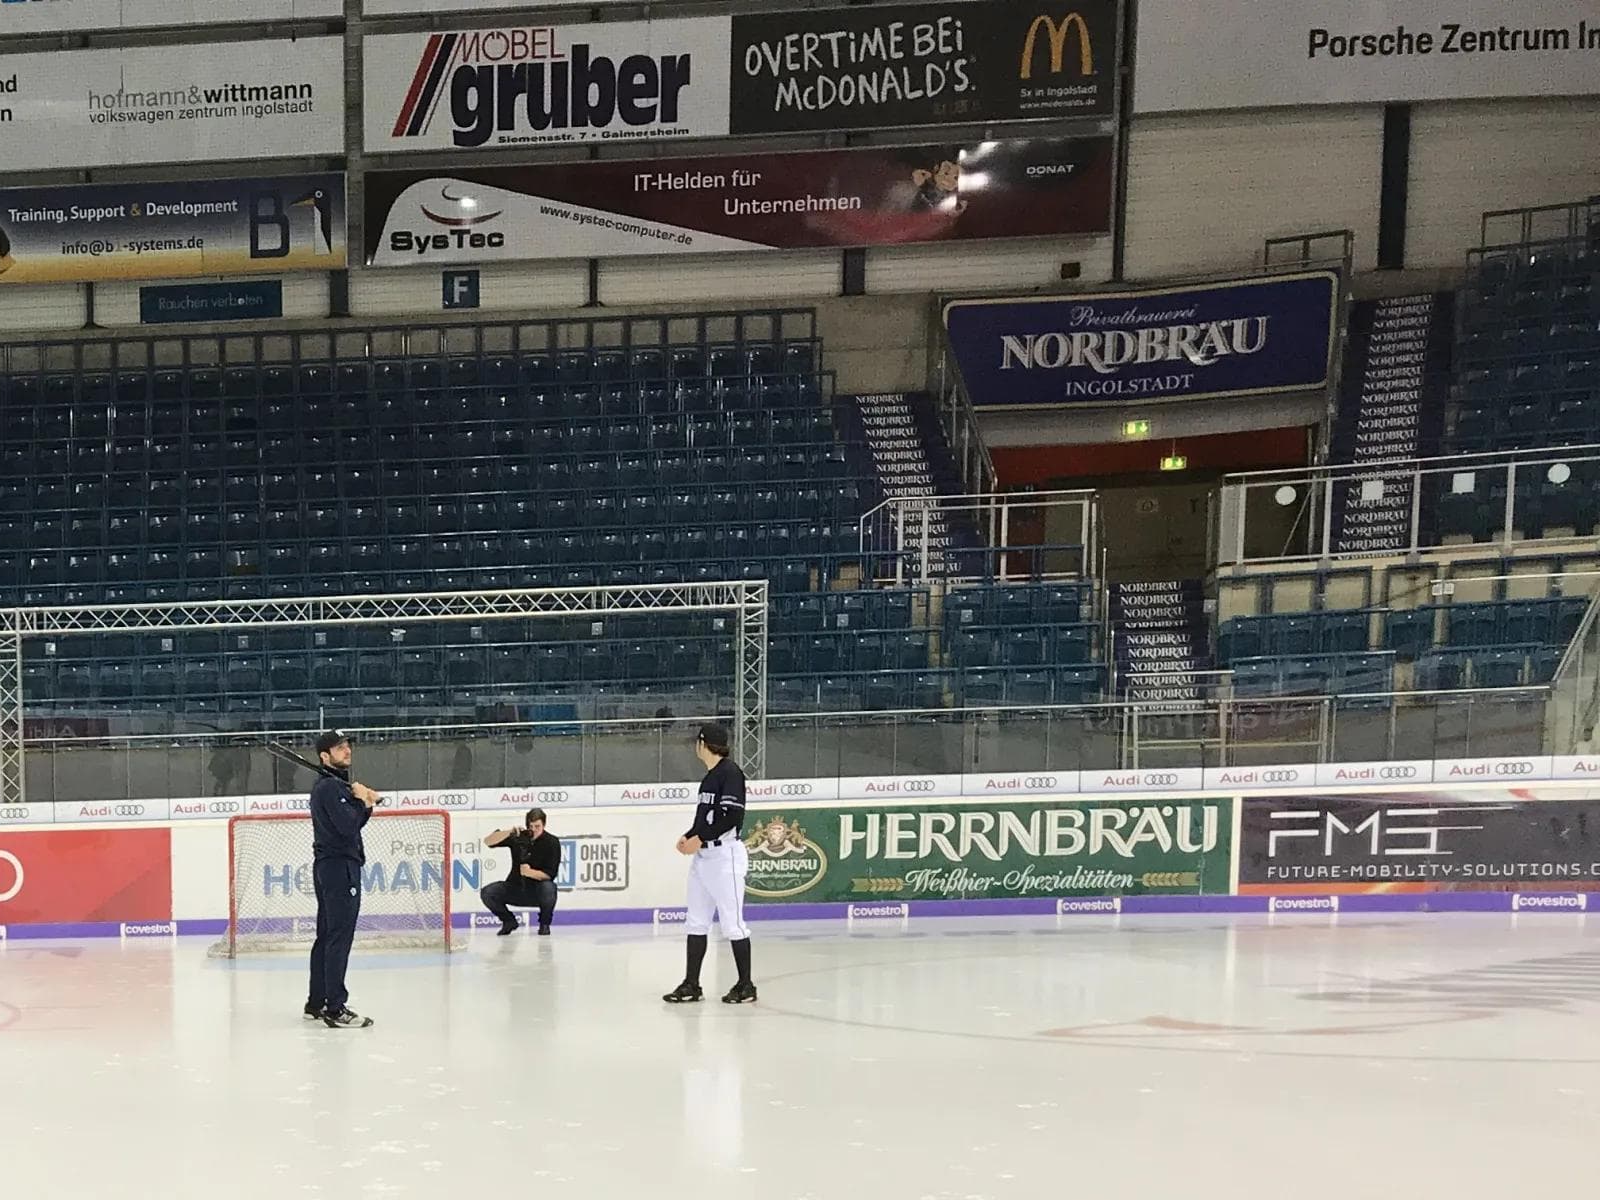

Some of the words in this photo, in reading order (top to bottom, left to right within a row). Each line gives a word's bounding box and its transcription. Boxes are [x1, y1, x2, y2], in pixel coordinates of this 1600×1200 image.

[455, 28, 565, 62] MÖBEL
[745, 22, 904, 77] OVERTIME
[913, 17, 963, 56] BEI
[1308, 26, 1433, 59] Porsche
[1440, 23, 1569, 54] Zentrum
[450, 44, 690, 147] gruber
[89, 108, 174, 124] volkswagen
[179, 106, 237, 120] zentrum
[242, 101, 313, 117] ingolstadt
[498, 134, 575, 144] Siemensstr.
[579, 132, 588, 140] 7
[601, 128, 690, 139] Gaimersheim
[633, 173, 725, 192] IT-Helden
[732, 171, 761, 188] für
[8, 205, 68, 224] Training,
[70, 204, 126, 222] Support
[130, 203, 141, 217] &
[146, 200, 238, 218] Development
[724, 195, 861, 216] Unternehmen
[540, 204, 693, 246] www.systec-computer.de
[454, 276, 468, 303] F
[158, 295, 208, 311] Rauchen
[212, 291, 264, 309] verboten
[1070, 304, 1198, 326] Privatbrauerei
[999, 316, 1269, 374] NORDBRÄU
[1066, 374, 1193, 396] INGOLSTADT
[1220, 772, 1258, 784] Audi
[1335, 767, 1375, 780] Audi
[1449, 763, 1491, 777] Audi
[865, 781, 900, 793] Audi
[985, 778, 1021, 790] Audi
[1103, 774, 1140, 787] Audi
[501, 792, 534, 803] Audi
[621, 788, 655, 800] Audi
[745, 785, 777, 797] Audi
[173, 802, 206, 814] Audi
[250, 800, 283, 812] Audi
[401, 795, 434, 806] Audi
[79, 806, 112, 817] Audi
[839, 806, 1218, 861] HERRNBRÄU
[1268, 809, 1452, 857] FMS
[580, 844, 618, 861] OHNE
[263, 858, 482, 898] HOMANN
[580, 862, 622, 883] JOB.
[1063, 900, 1114, 911] covestro
[1275, 898, 1331, 909] covestro
[1519, 895, 1578, 907] covestro
[853, 905, 902, 917] covestro
[476, 914, 522, 926] coveo
[125, 924, 172, 935] covestro
